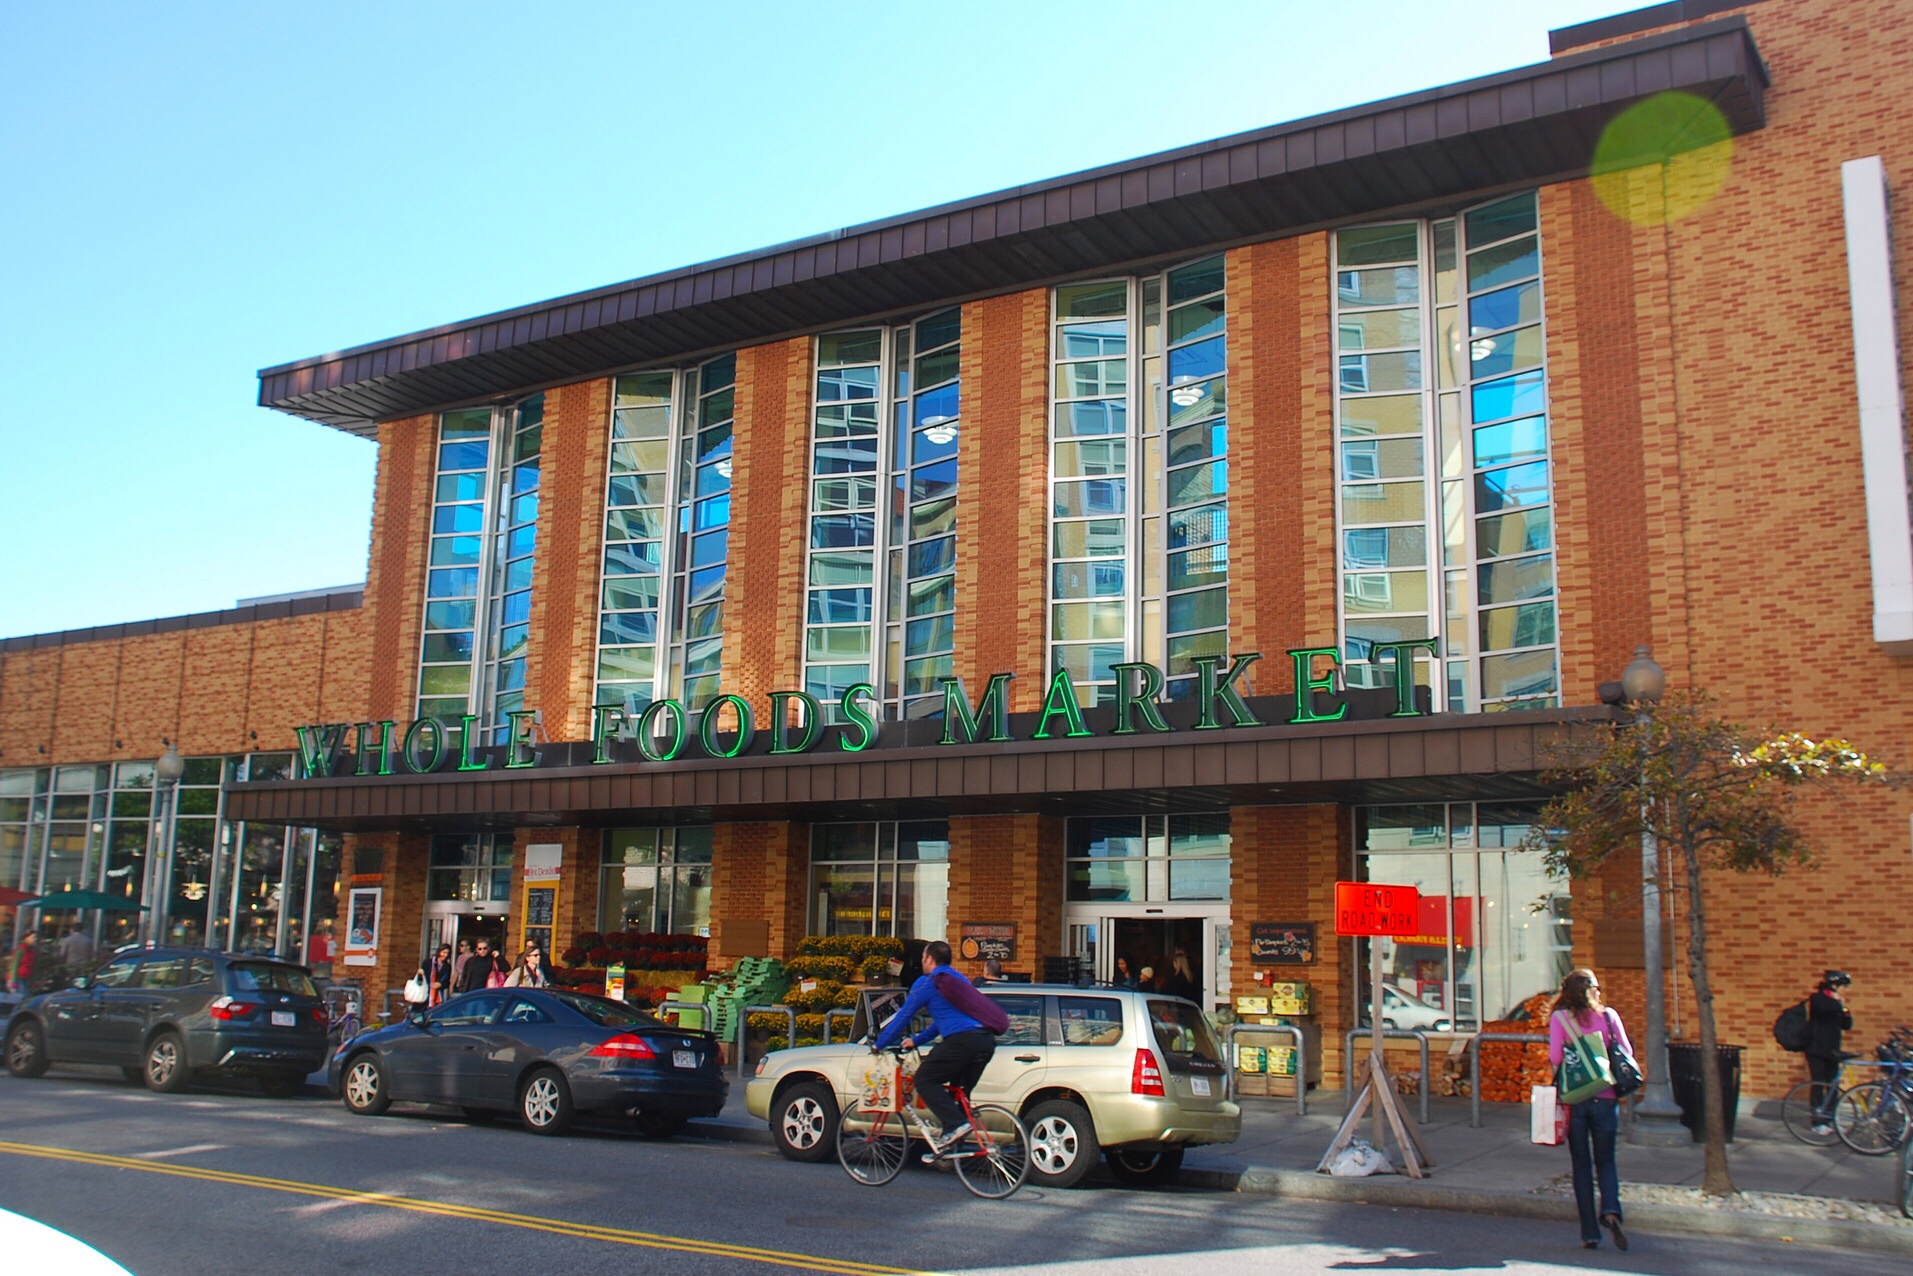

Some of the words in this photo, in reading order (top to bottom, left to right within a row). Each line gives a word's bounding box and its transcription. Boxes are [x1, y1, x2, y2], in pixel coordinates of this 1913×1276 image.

[296, 709, 543, 778] WHOLE
[592, 682, 879, 765] FOODS
[936, 637, 1441, 745] MARKET
[1364, 889, 1394, 908] END
[1342, 911, 1376, 930] ROAD
[1381, 913, 1413, 931] WORK
